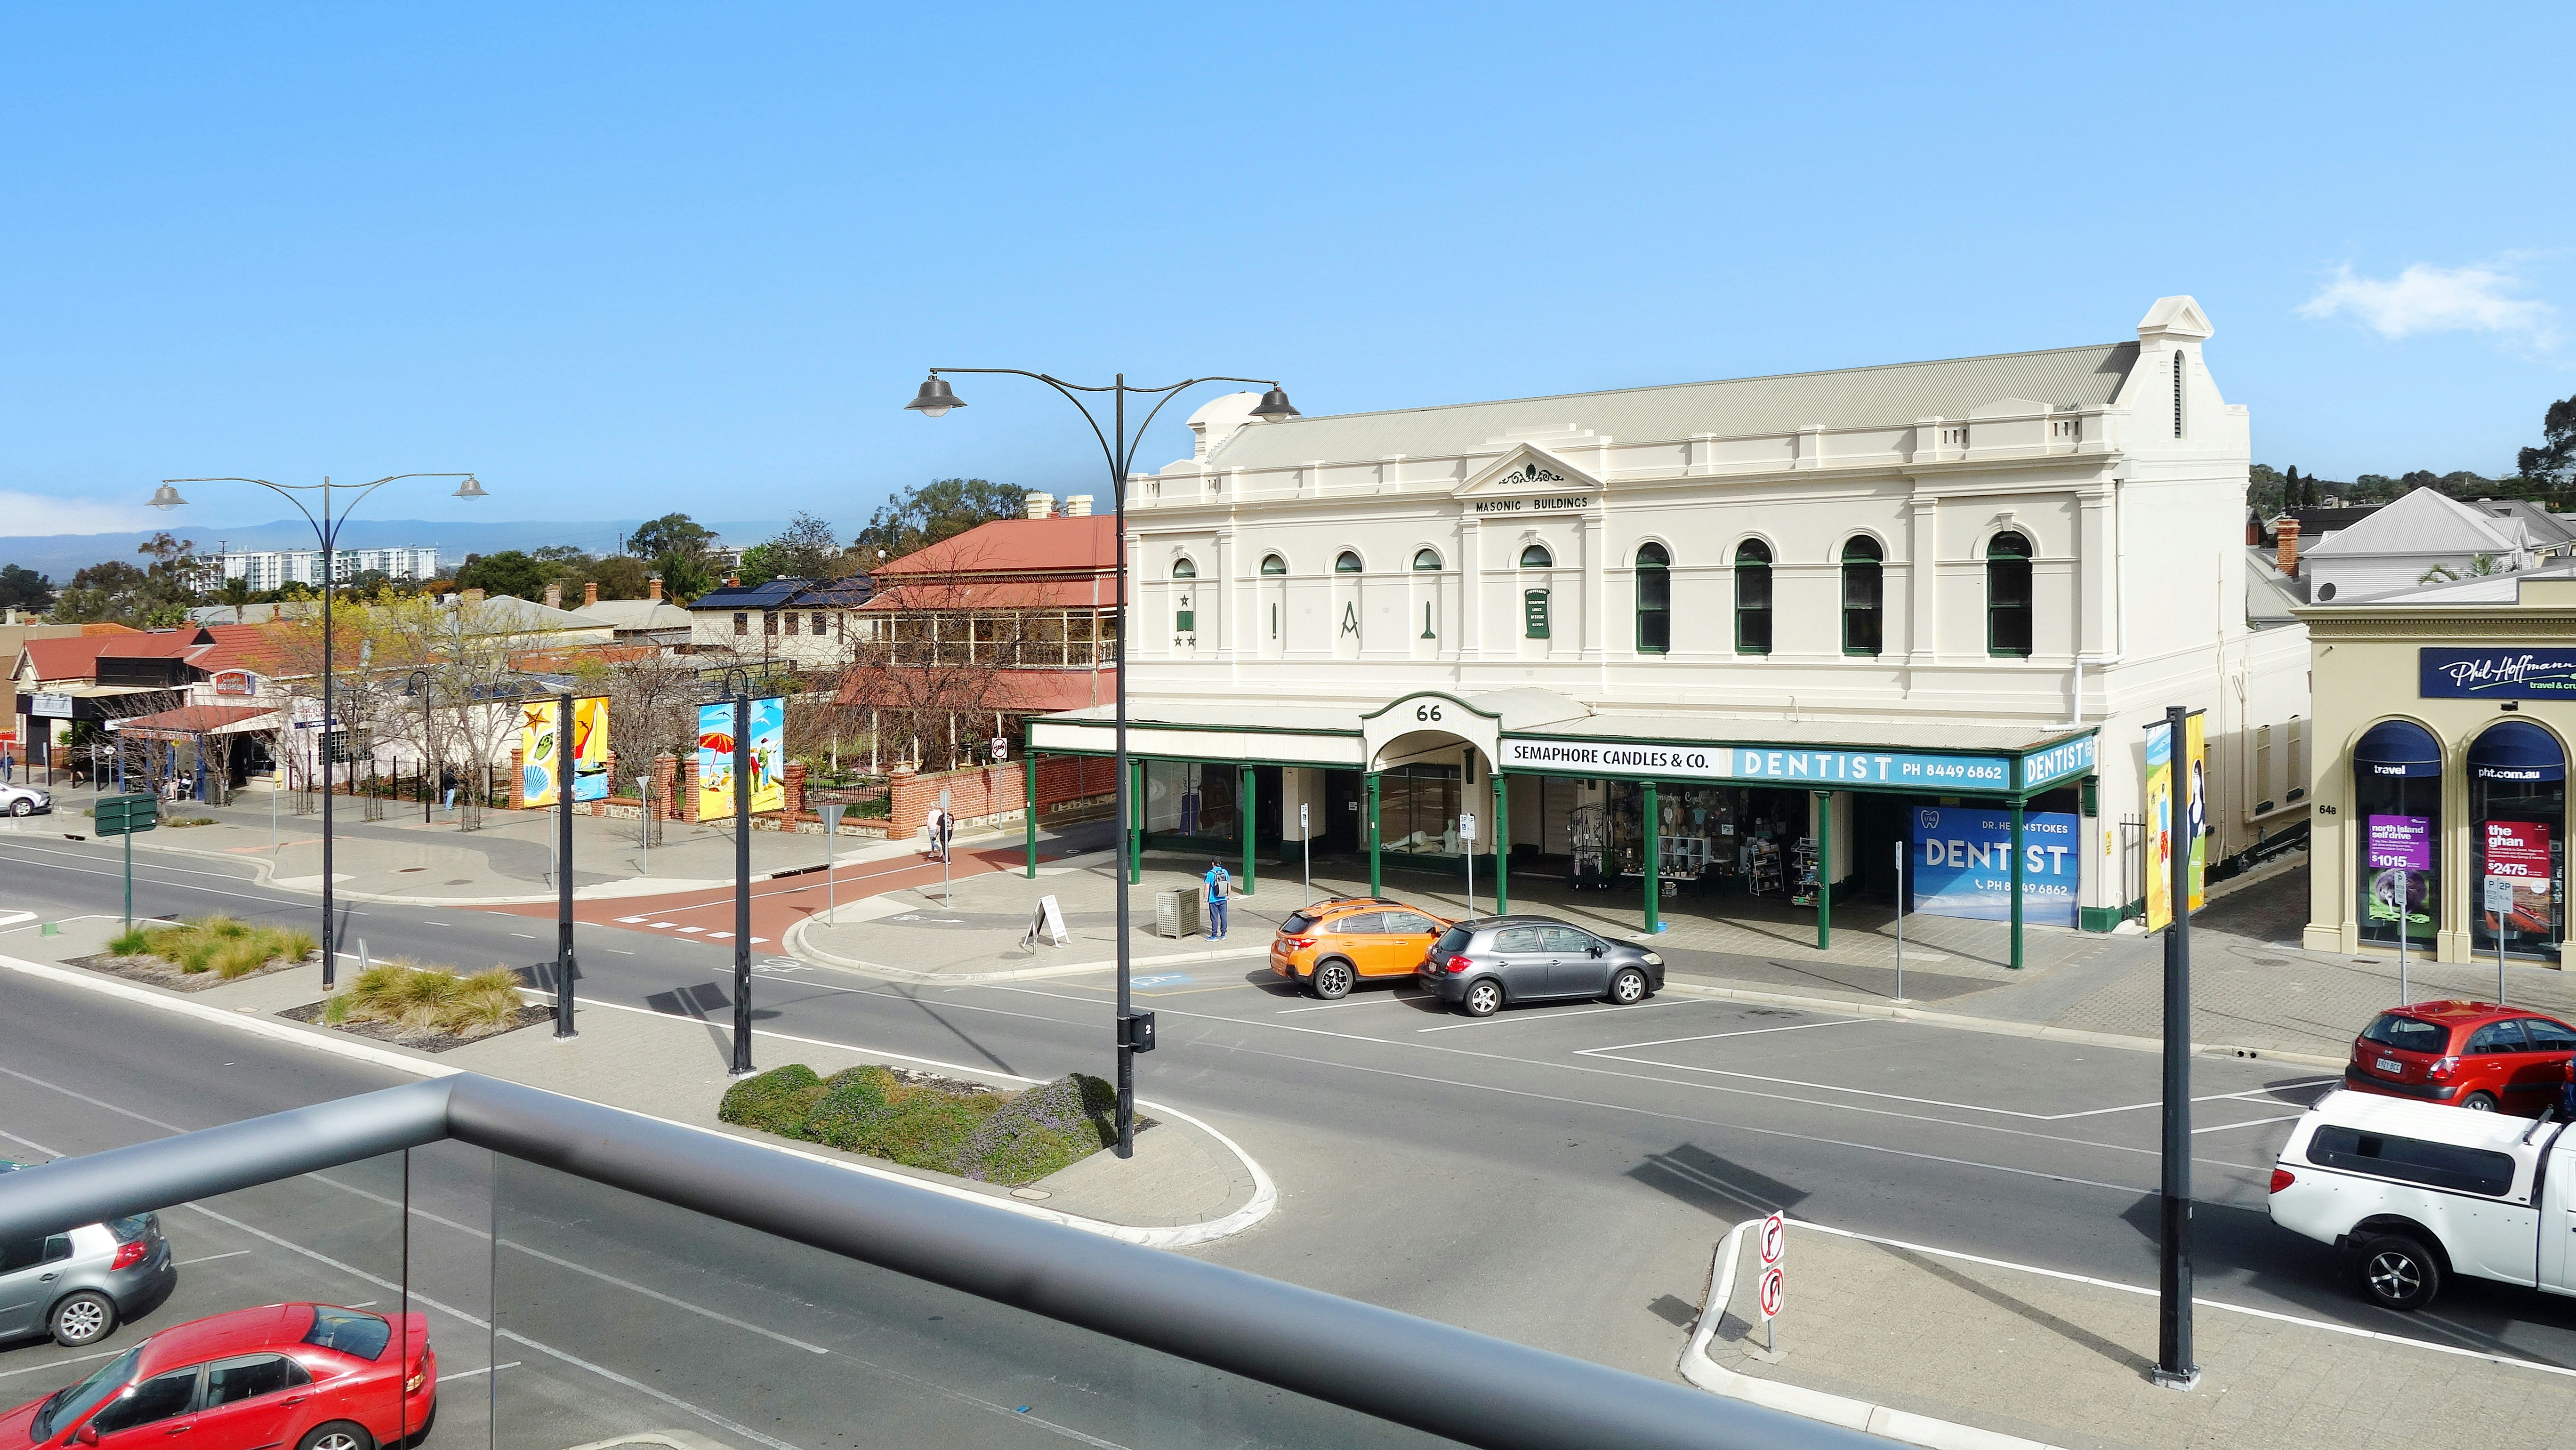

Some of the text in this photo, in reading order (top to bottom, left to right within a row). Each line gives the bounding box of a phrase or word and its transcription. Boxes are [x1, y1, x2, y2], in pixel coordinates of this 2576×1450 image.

[1476, 497, 1587, 512] MASONIC BUILDINGS
[2439, 655, 2576, 687] Phil Hoffmann
[1417, 705, 1442, 721] 66
[1514, 746, 1709, 768] SEMAPHORE CANDLES & CO.
[2028, 742, 2084, 783] DENTIST
[1745, 751, 2002, 780] DENTIST PH 8449 6862
[2374, 765, 2406, 775] travel
[2479, 768, 2540, 779] pht.com.au
[2319, 805, 2336, 815] 64B
[1982, 821, 2068, 834] DR. HEN STOKES
[2397, 825, 2423, 833] island
[2487, 825, 2512, 836] the
[2389, 832, 2411, 840] drive
[2488, 835, 2524, 847] ghan
[1926, 838, 2068, 875] DENTST
[2372, 854, 2407, 867] $1015
[2488, 862, 2528, 876] $2475
[1987, 880, 2068, 896] PH 849 6862
[2499, 882, 2511, 890] 2P
[1145, 1024, 1151, 1035] 2
